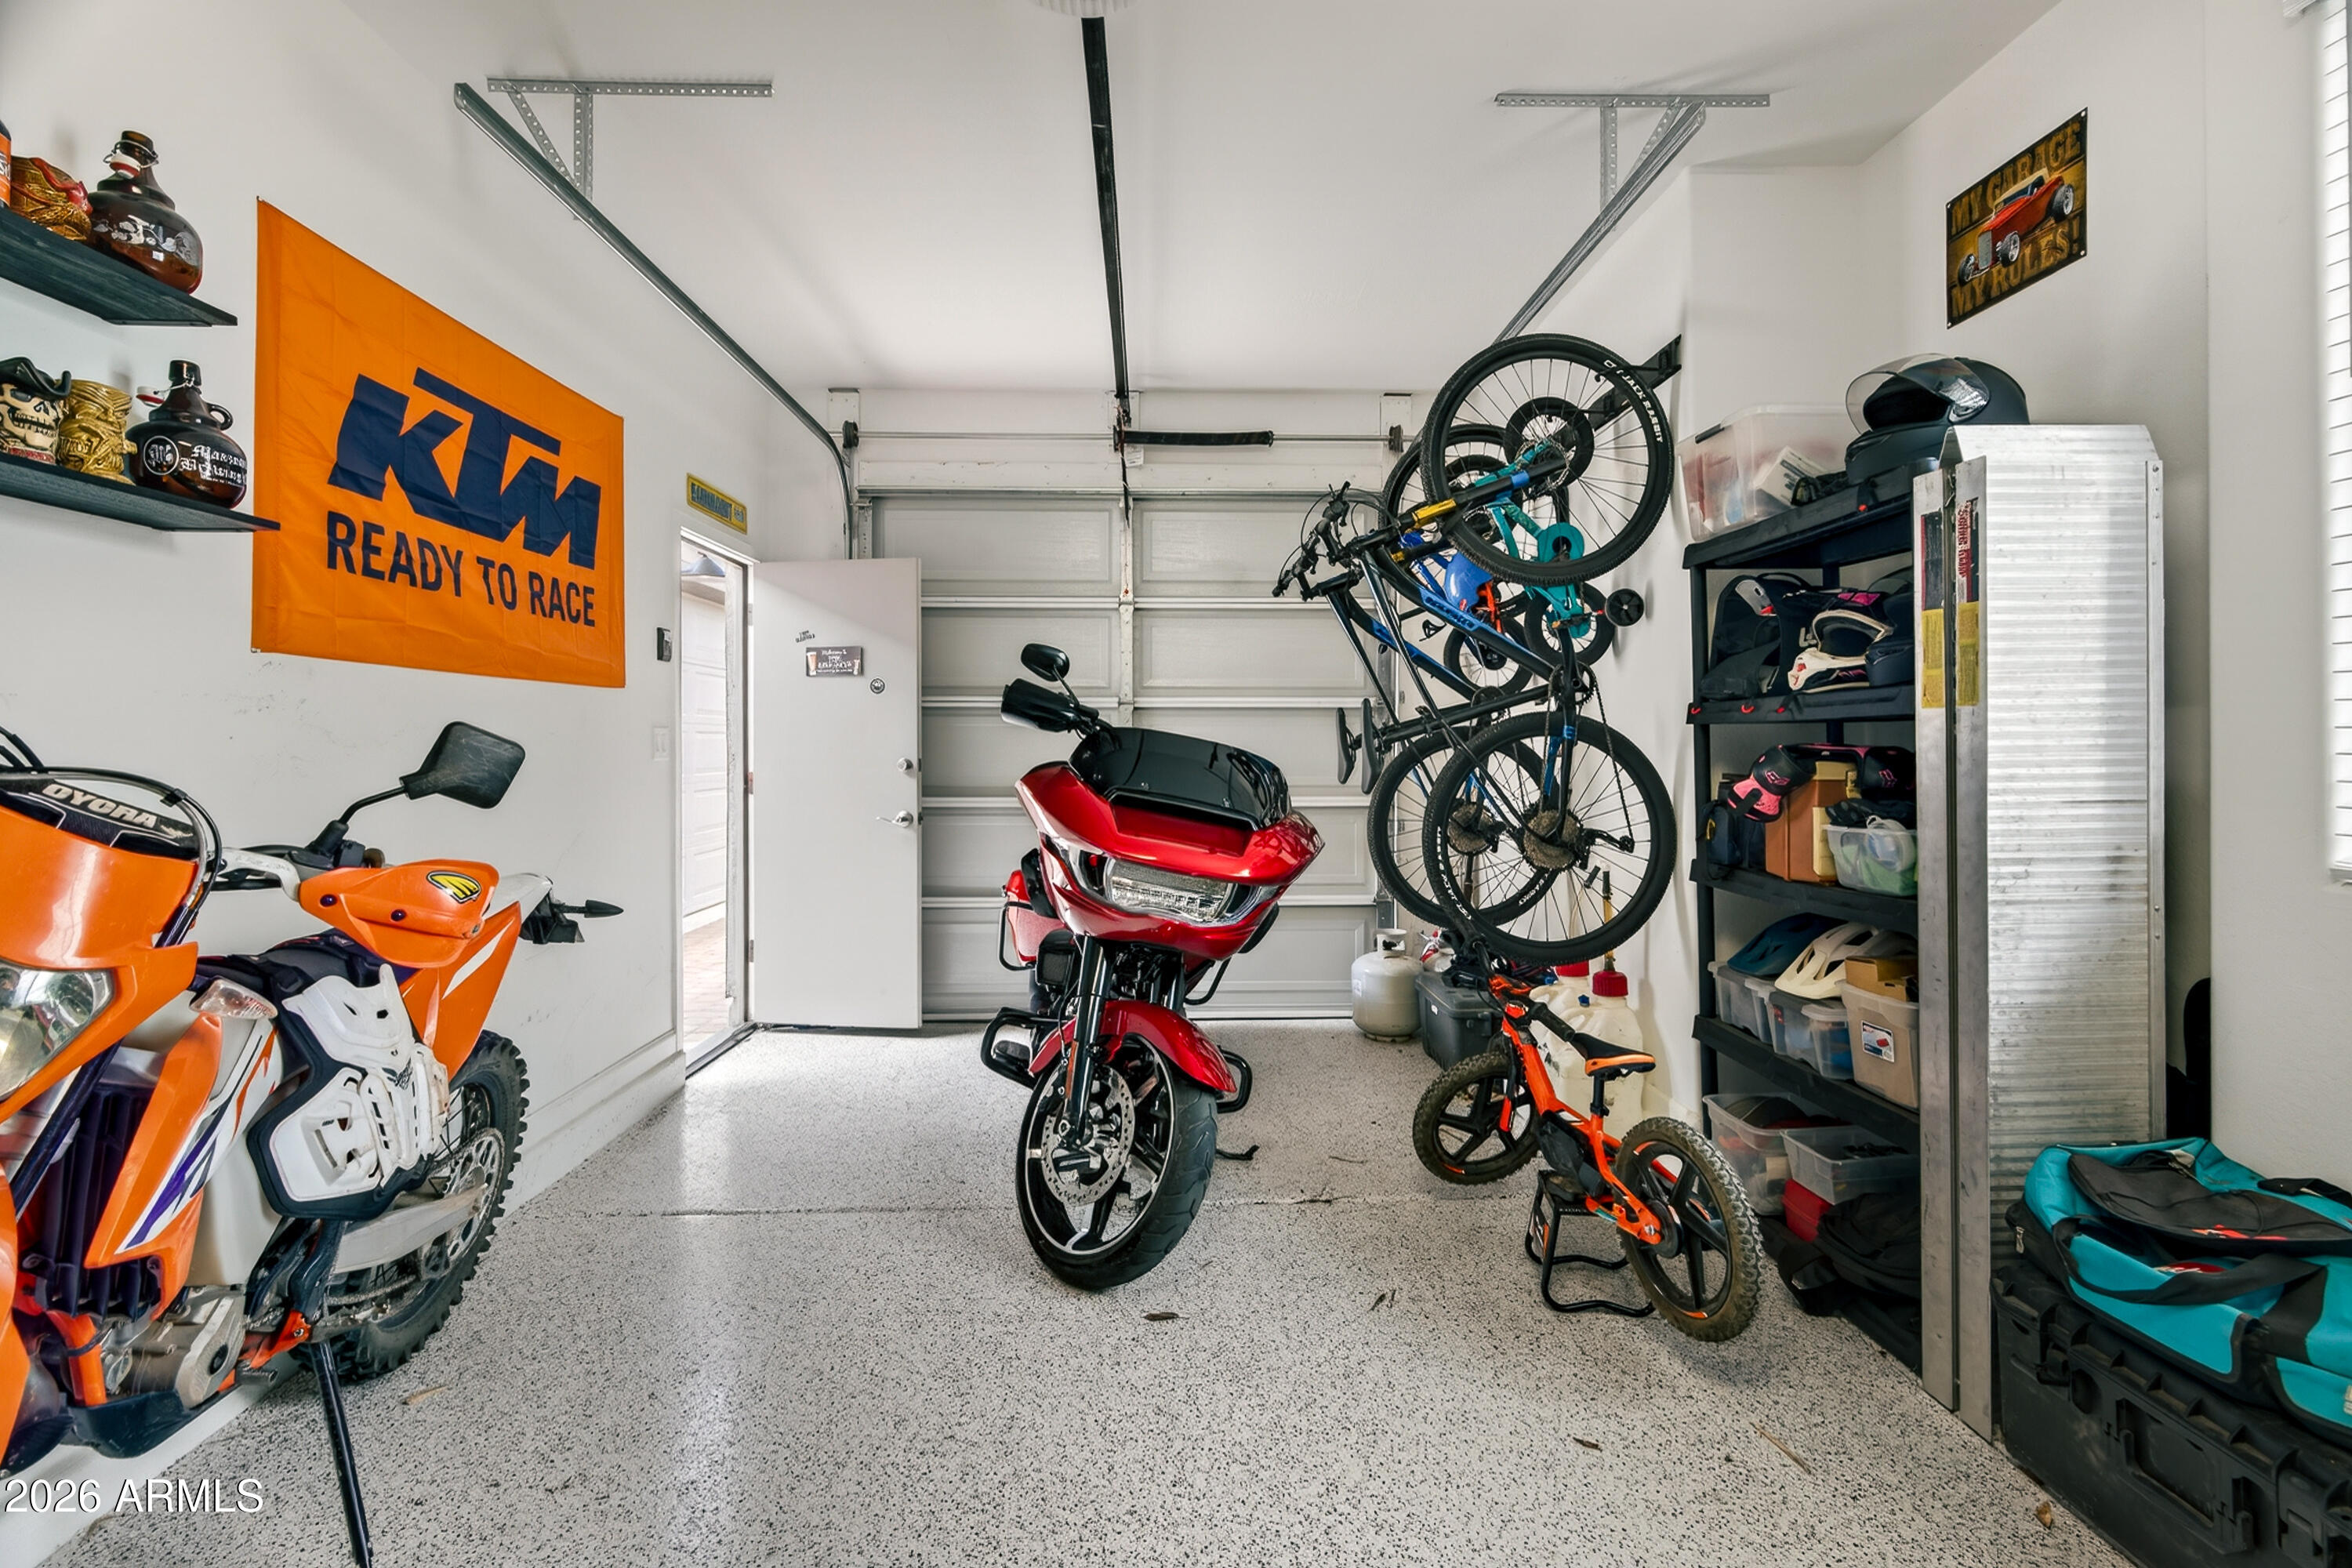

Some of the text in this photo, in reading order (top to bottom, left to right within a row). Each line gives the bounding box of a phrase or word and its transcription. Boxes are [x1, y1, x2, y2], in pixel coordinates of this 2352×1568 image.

[1951, 122, 2082, 235] MY GARAGE
[1951, 274, 1987, 317] MY
[328, 367, 601, 571] KTM
[327, 510, 596, 628] READY TO RACE
